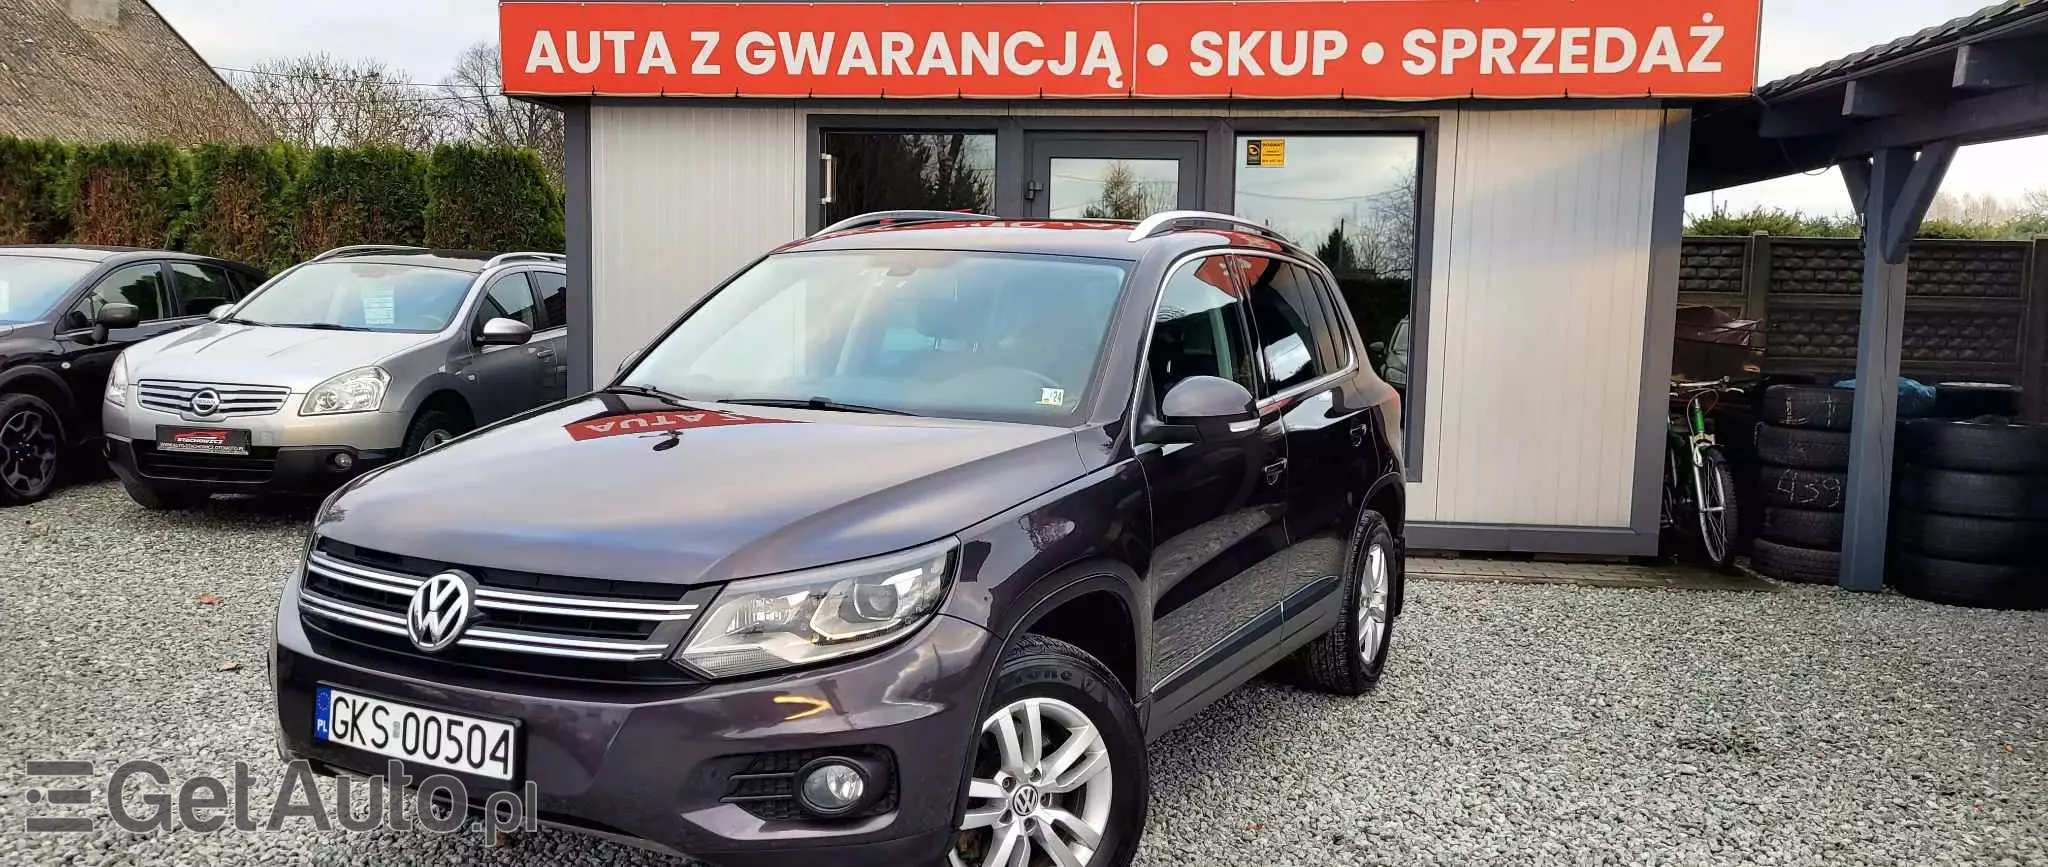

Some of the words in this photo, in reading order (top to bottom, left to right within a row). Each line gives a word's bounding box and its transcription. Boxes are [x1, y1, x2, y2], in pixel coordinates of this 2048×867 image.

[525, 30, 677, 75] AUTA
[690, 31, 721, 75] Z
[735, 30, 1124, 88] GWARANCJĄ
[1189, 30, 1348, 76] SKUP
[1401, 12, 1725, 75] SPRZEDAŻ
[317, 719, 328, 732] PL
[331, 696, 390, 749] GKS
[401, 711, 510, 775] 00504
